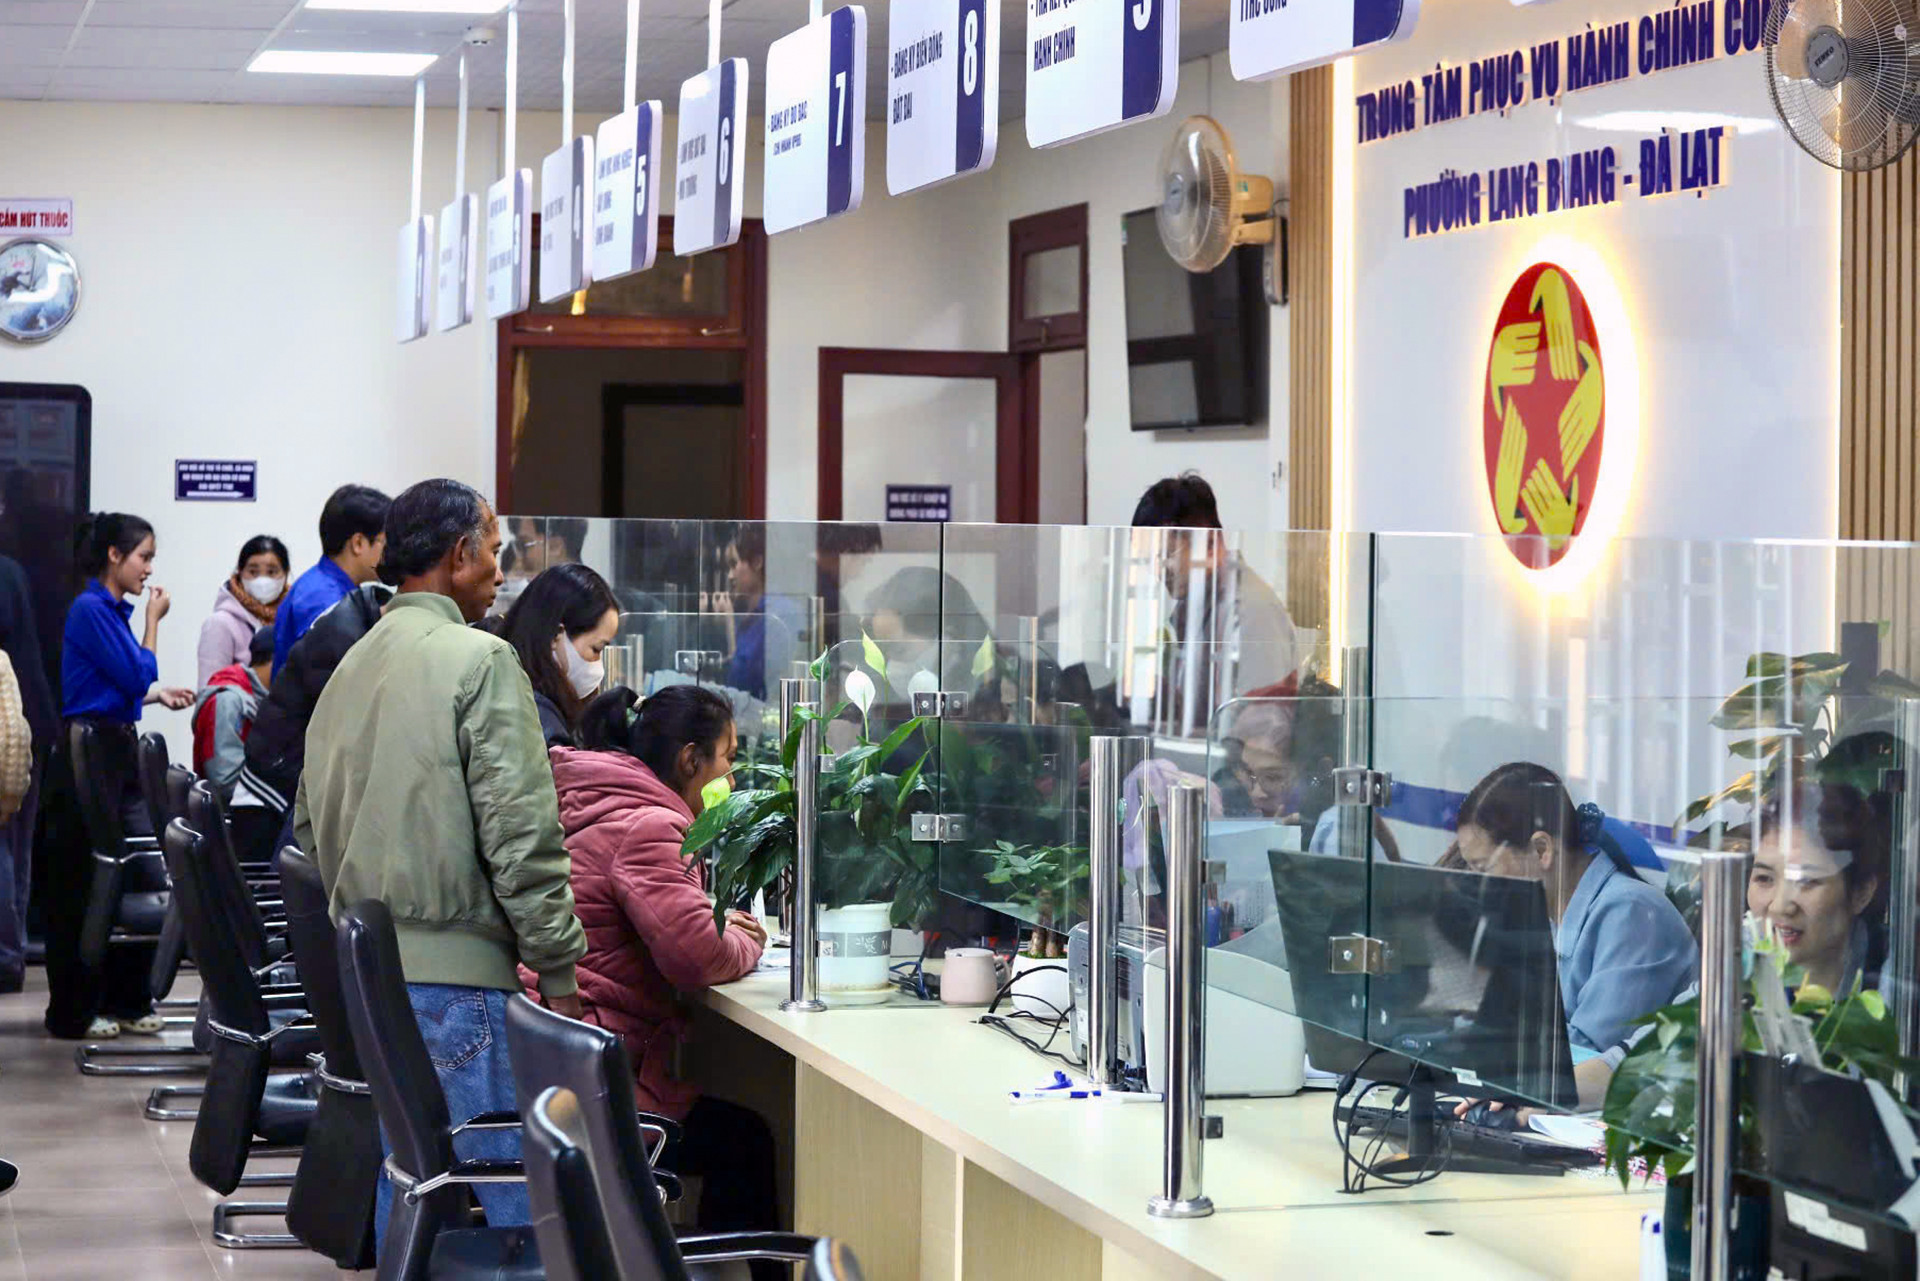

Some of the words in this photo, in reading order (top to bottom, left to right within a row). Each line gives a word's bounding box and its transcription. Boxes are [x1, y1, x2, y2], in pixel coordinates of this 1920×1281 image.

[963, 9, 979, 97] 8
[1356, 79, 1416, 144] TRUNG
[1422, 62, 1462, 126] TÂM
[1468, 50, 1524, 118] PHỤC
[1530, 40, 1559, 106] VỤ
[1566, 21, 1630, 93] HÀNH
[1638, 0, 1716, 75] CHÍNH
[835, 70, 847, 147] 7
[635, 154, 647, 217] 5
[718, 116, 730, 186] 6
[1403, 167, 1481, 239] PHƯỜNG
[1487, 161, 1539, 223] LANG
[1546, 146, 1616, 213] BIANG
[1622, 173, 1633, 187] -
[1639, 126, 1673, 198] ĐÀ
[1679, 126, 1725, 199] LẠT
[0, 205, 17, 228] CẤM
[20, 207, 37, 228] HÚT
[39, 207, 68, 229] THUỐC
[573, 183, 581, 241] 4
